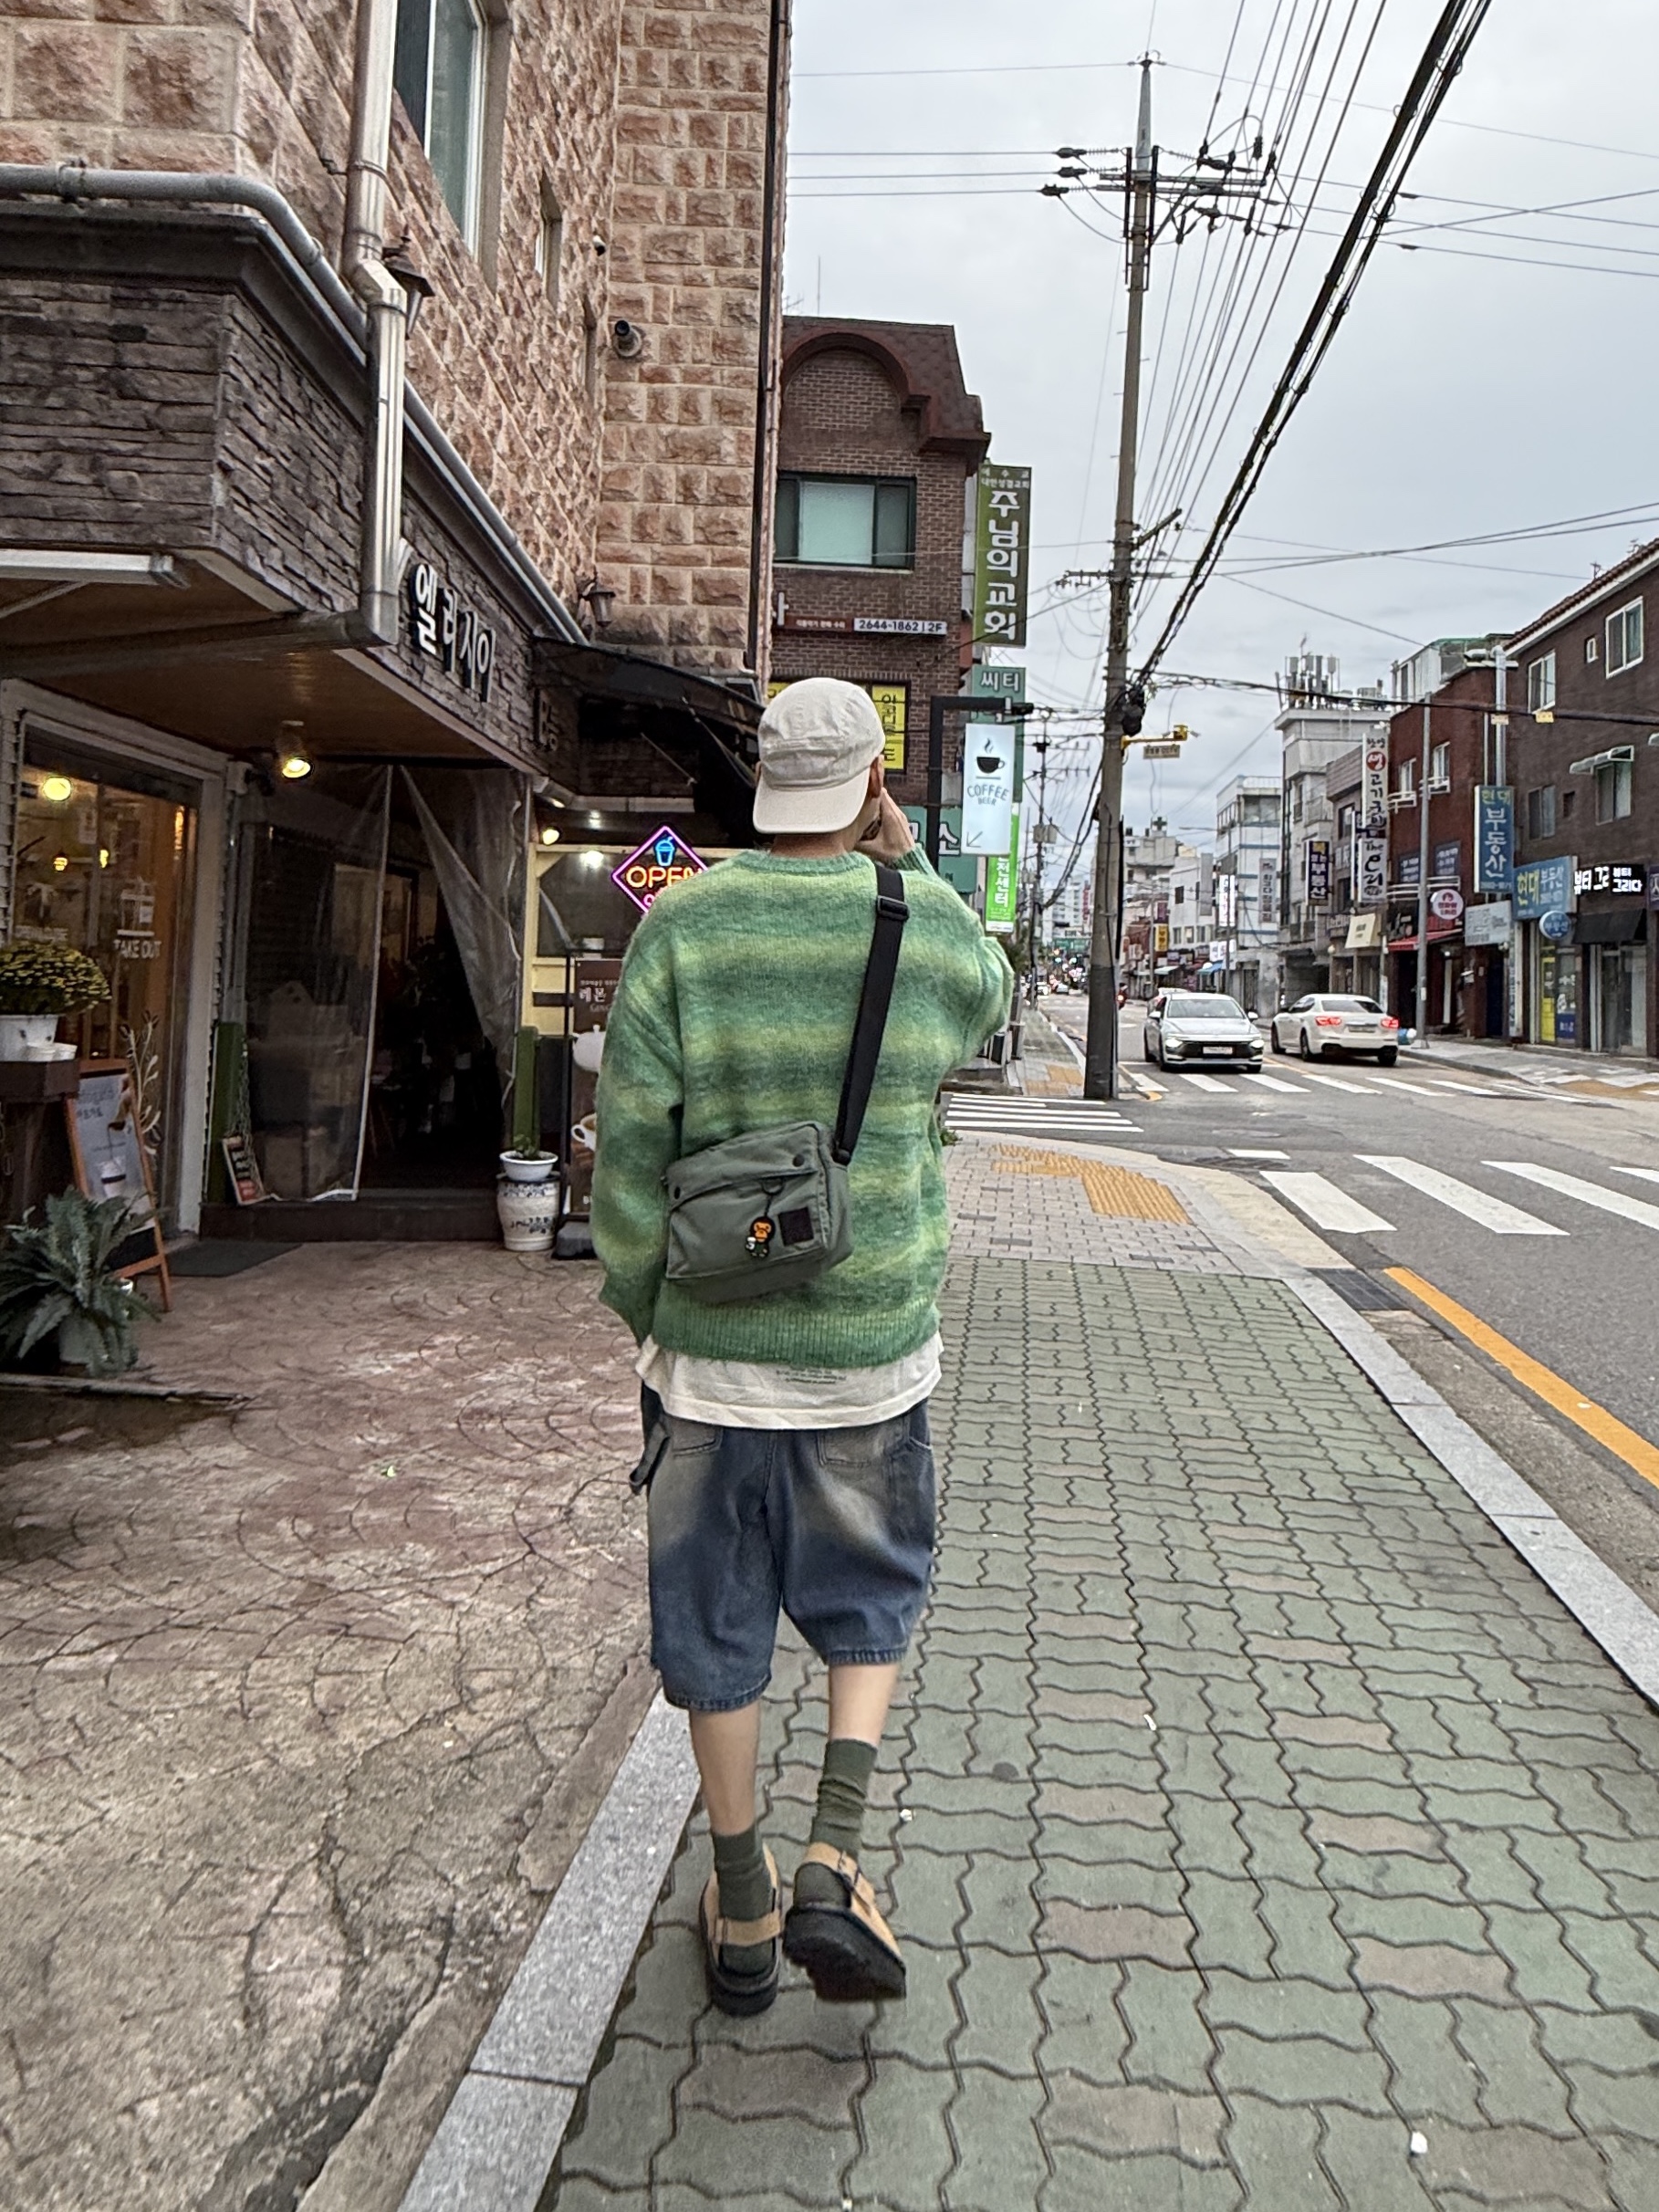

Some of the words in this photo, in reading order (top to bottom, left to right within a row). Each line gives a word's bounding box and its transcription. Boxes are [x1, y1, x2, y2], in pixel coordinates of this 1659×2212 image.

[859, 620, 919, 631] 2644-1862
[929, 622, 943, 632] 2F
[981, 672, 1019, 692] 씨티
[966, 784, 1010, 801] COFFEE
[1484, 808, 1508, 878] 부동산
[1612, 879, 1643, 893] 그리다
[113, 939, 140, 958] TAKE
